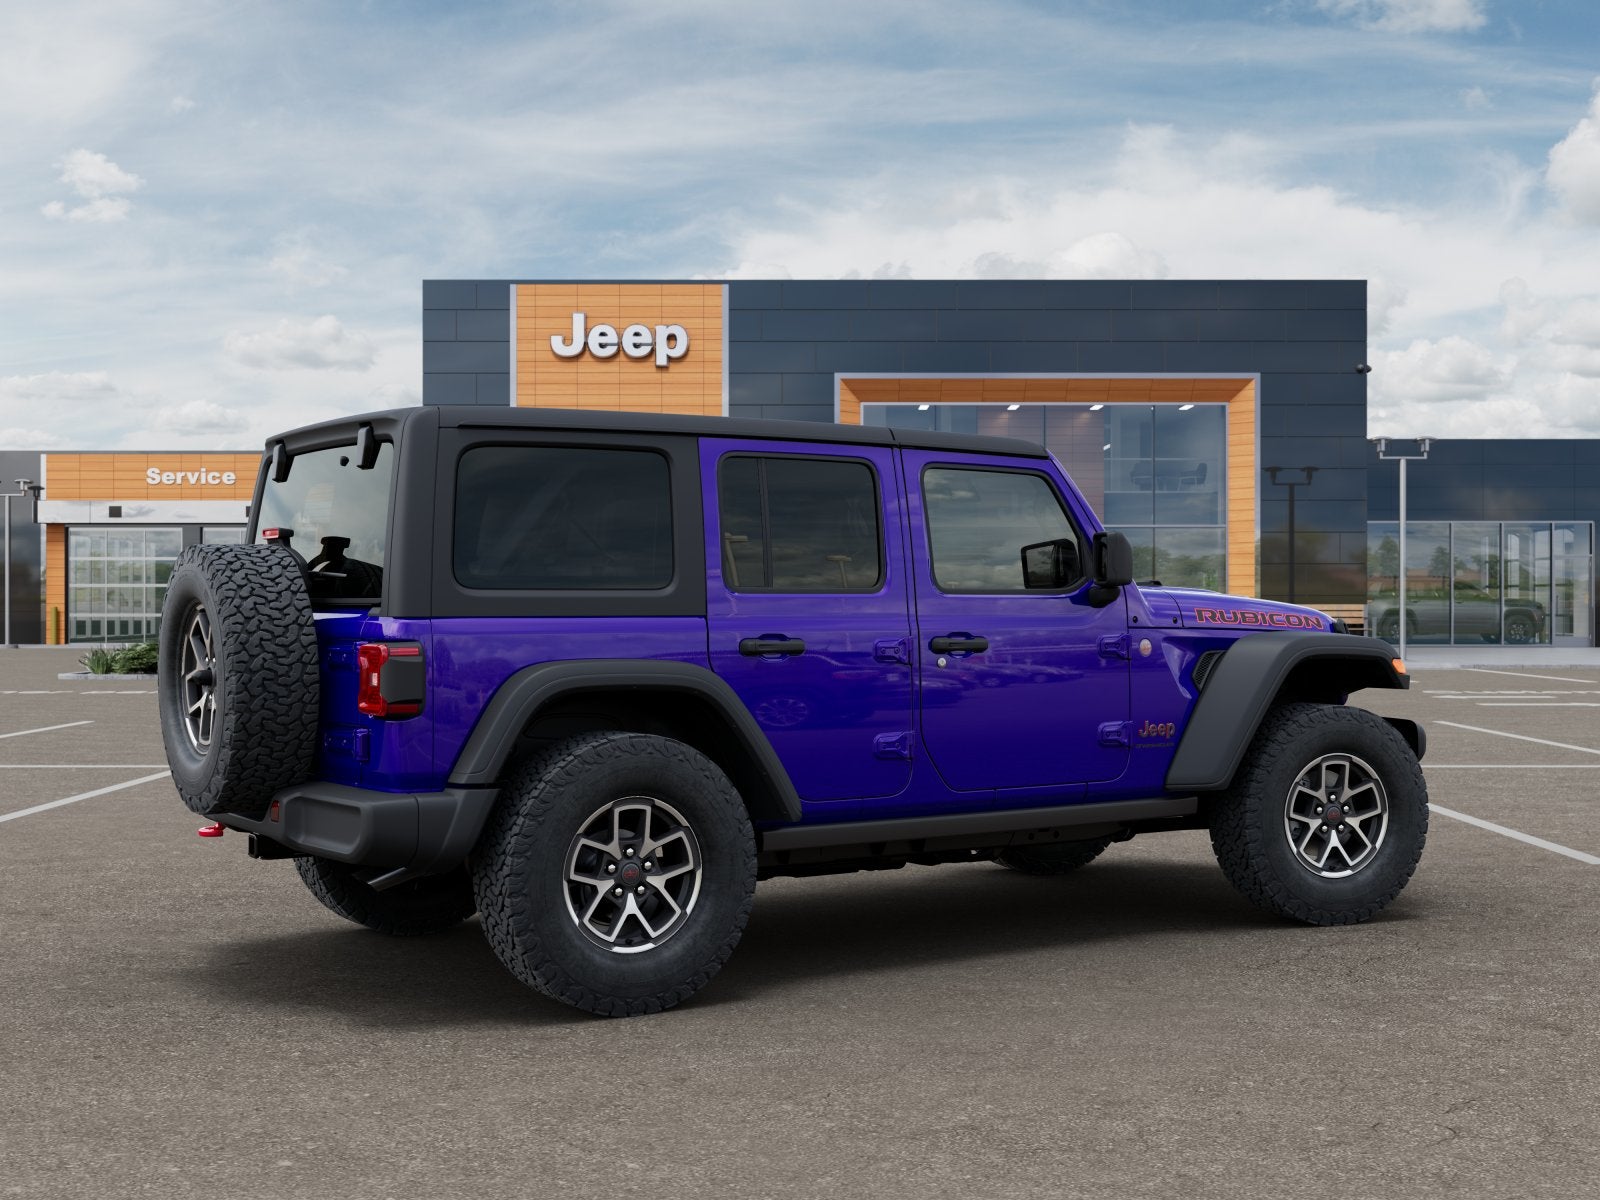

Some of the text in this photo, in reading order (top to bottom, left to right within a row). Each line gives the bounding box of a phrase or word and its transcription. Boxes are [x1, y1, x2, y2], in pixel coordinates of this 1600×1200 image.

[550, 312, 689, 368] Jeep
[146, 467, 236, 485] Service
[1194, 607, 1324, 630] RUBICON
[1138, 720, 1176, 739] Jeep
